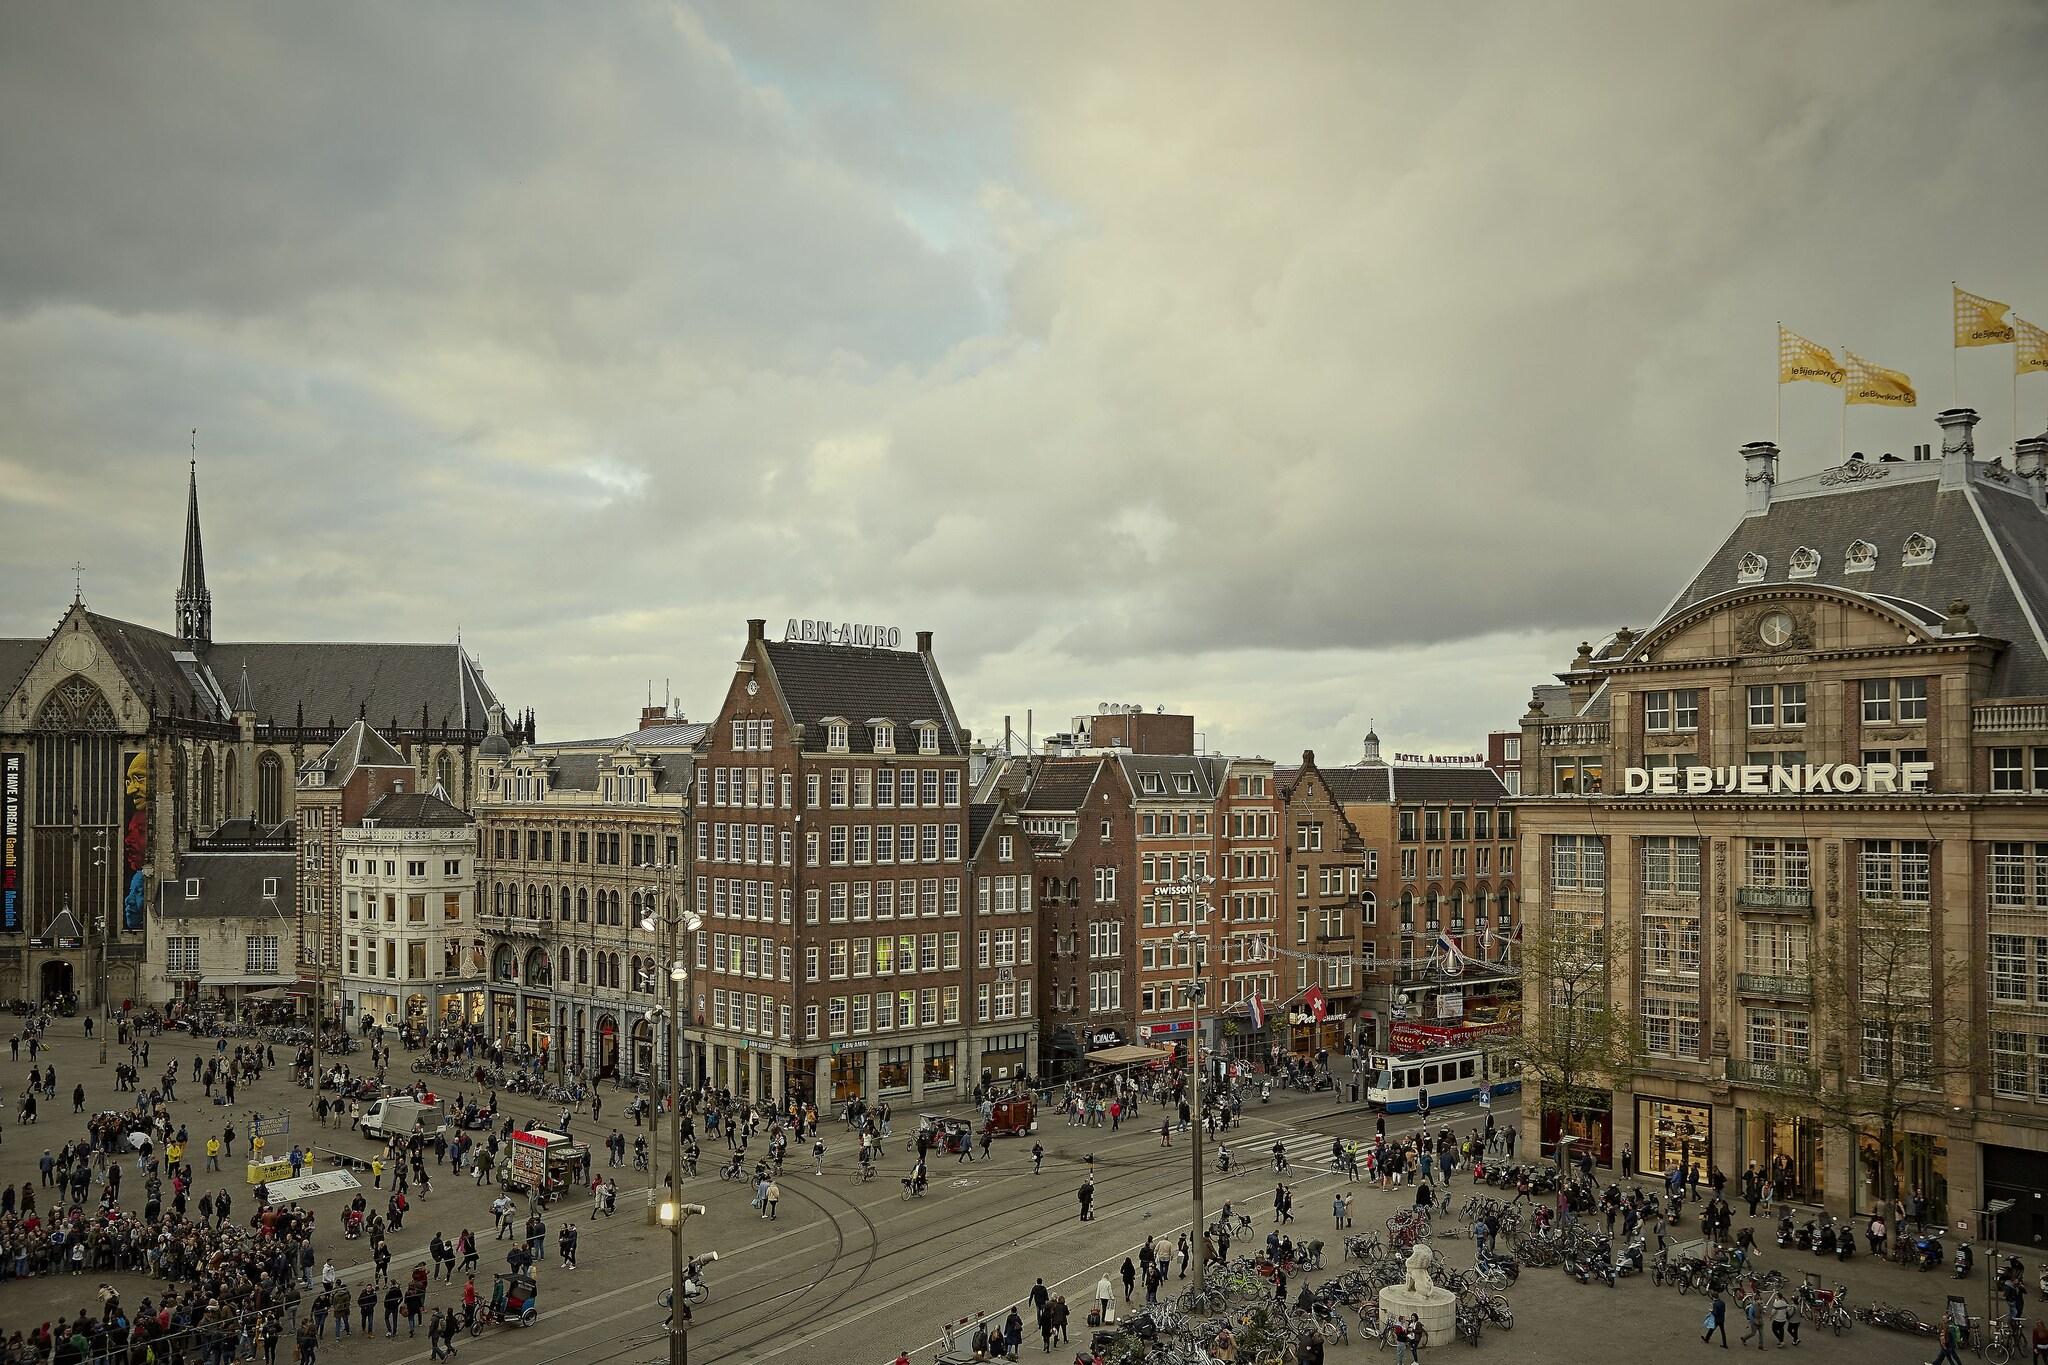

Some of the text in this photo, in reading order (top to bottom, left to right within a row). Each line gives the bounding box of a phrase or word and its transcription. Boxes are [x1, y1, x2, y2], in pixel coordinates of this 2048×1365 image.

[7, 757, 19, 771] WE
[1395, 752, 1484, 764] HOTEL AMSTERDAM
[6, 773, 19, 795] HAVE
[1624, 761, 1935, 794] DE BIJENKORF
[6, 805, 18, 835] DREAM
[5, 837, 17, 867] Gandhi
[5, 890, 17, 927] Mandela
